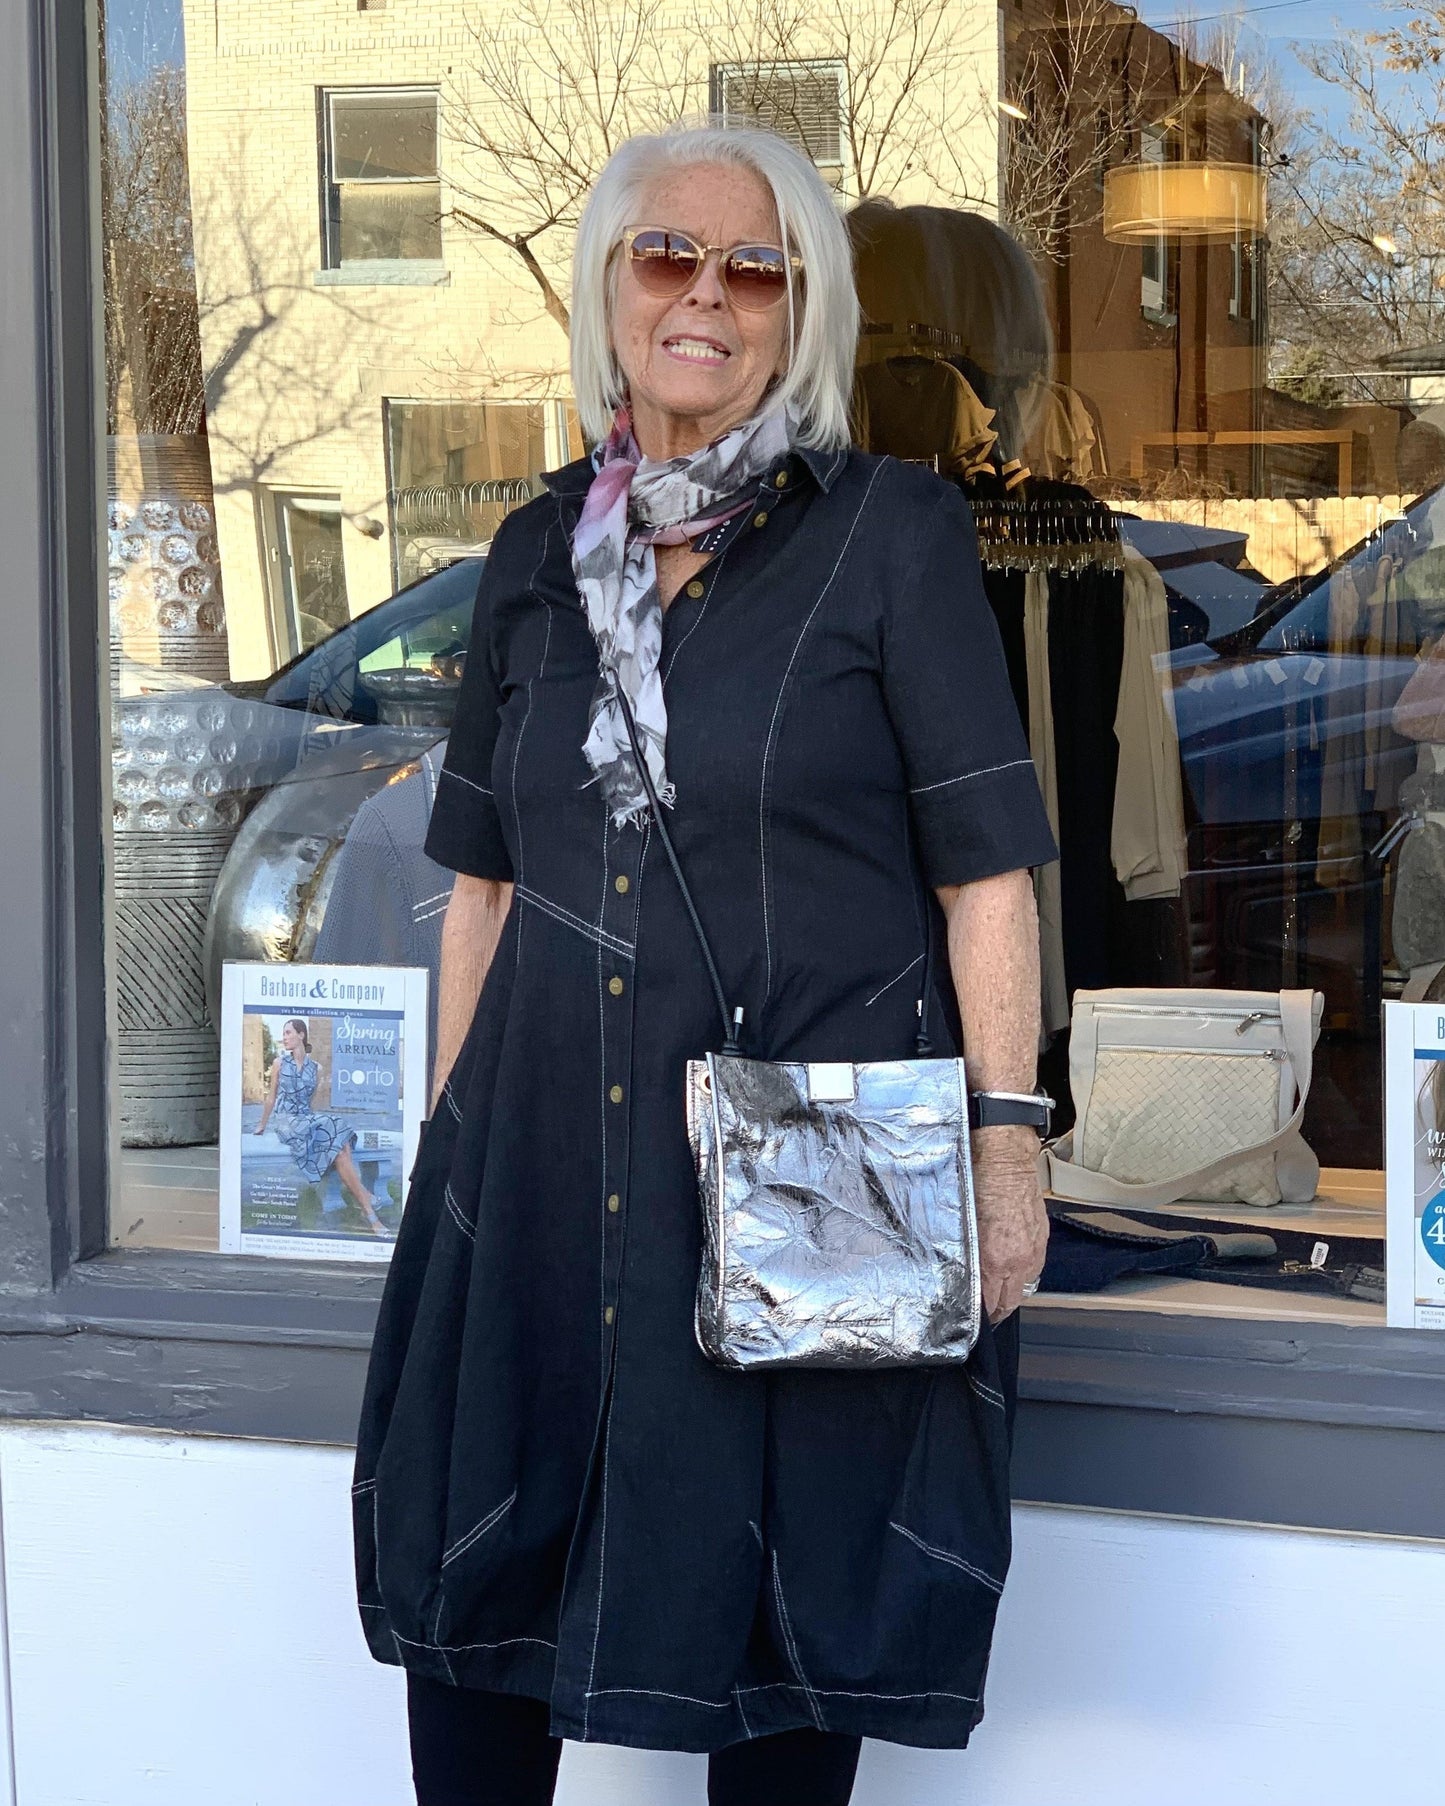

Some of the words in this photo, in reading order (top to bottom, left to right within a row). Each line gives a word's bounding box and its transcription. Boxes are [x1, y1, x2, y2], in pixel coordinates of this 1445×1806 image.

[261, 976, 306, 998] Barbara
[309, 979, 328, 999] &
[332, 978, 385, 1005] Company
[336, 1014, 395, 1050] Spring
[336, 1044, 396, 1056] ARRIVALS
[337, 1065, 394, 1091] porto
